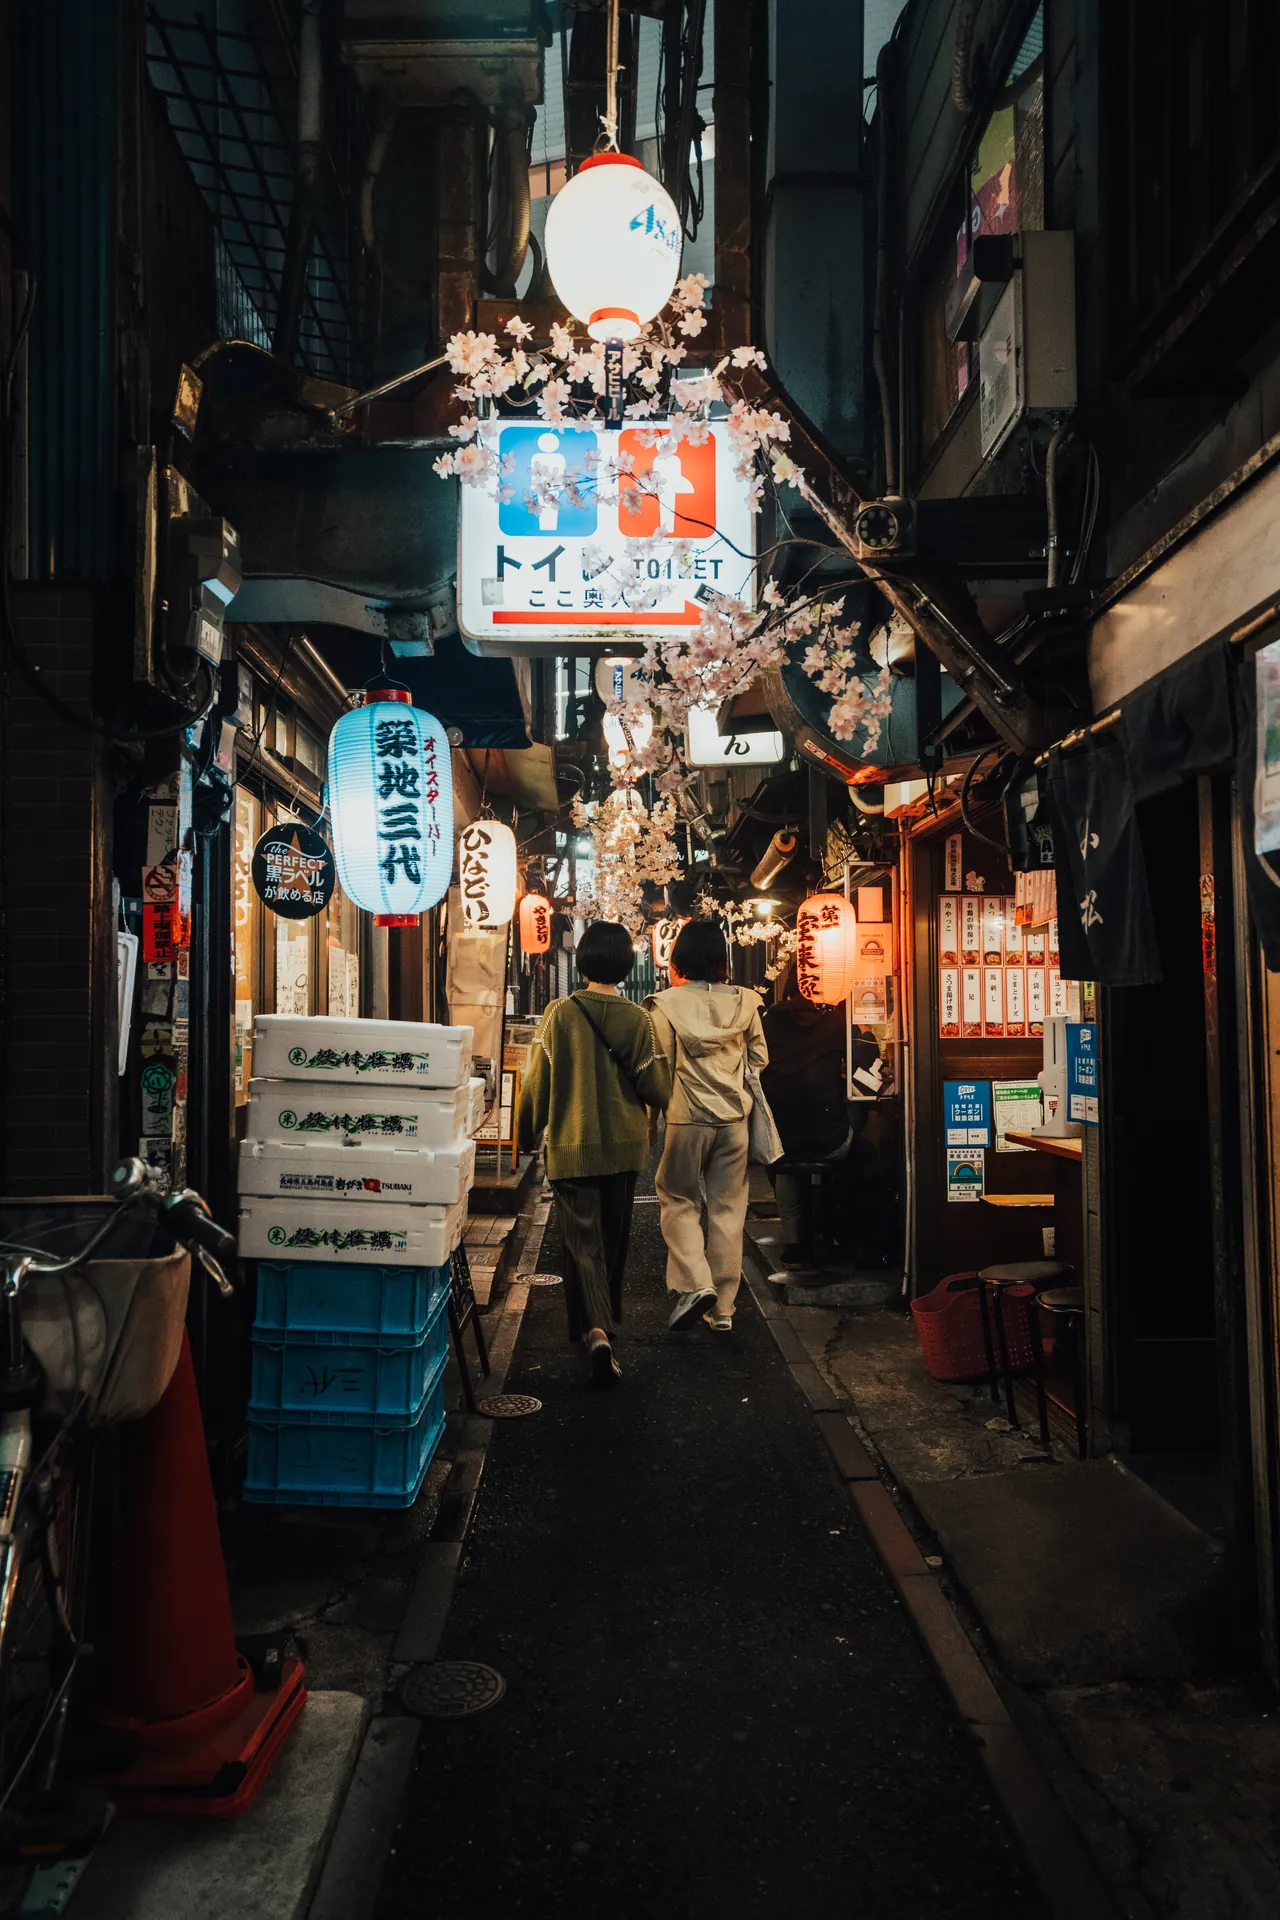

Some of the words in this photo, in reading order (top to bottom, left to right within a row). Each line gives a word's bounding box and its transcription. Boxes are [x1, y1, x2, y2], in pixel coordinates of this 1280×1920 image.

[607, 350, 622, 421] アサヒビール
[632, 558, 723, 580] TOIET
[529, 587, 658, 609] ここ奥入
[375, 719, 422, 885] 築地三代
[423, 736, 441, 857] オイスターバー
[270, 843, 288, 855] the
[266, 853, 325, 871] PERFECT
[265, 864, 325, 887] 黒ラベル
[264, 885, 325, 905] が飲める店
[944, 902, 952, 932] 冷やっこ
[988, 902, 996, 942] もつ込み
[968, 973, 975, 1000] 豚足
[335, 1177, 362, 1191] 岩がき
[381, 1182, 412, 1191] TSUBAKI
